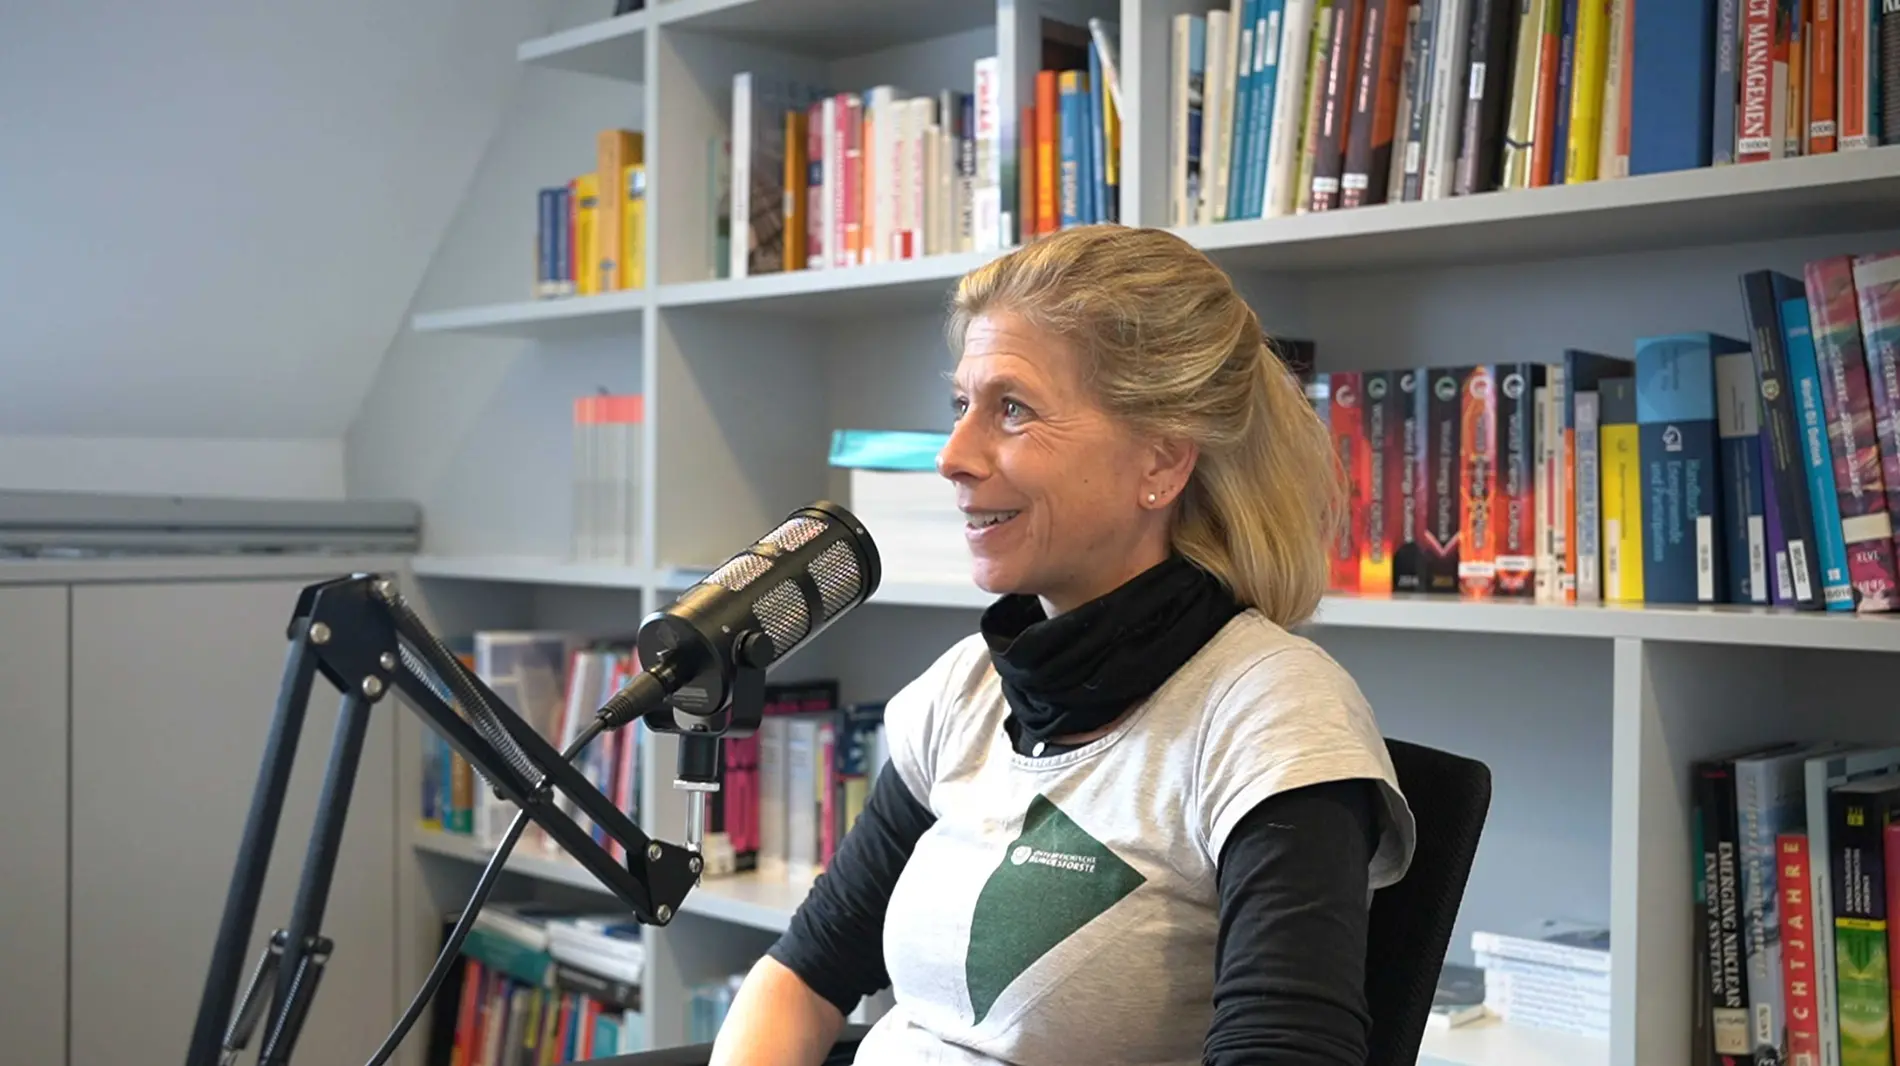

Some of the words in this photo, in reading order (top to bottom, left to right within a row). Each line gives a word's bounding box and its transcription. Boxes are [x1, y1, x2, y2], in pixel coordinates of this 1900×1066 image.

[1403, 419, 1416, 450] World
[1439, 420, 1451, 450] World
[1402, 453, 1415, 496] Energy
[1436, 454, 1450, 500] Energy
[1506, 453, 1522, 497] Energy
[1402, 498, 1415, 544] Outlook
[1438, 502, 1450, 543] Outlook
[1508, 501, 1522, 550] Outlook
[1704, 852, 1720, 915] ENERGY
[1719, 842, 1738, 932] EMERGING
[1708, 919, 1724, 994] SYSTEMS
[1722, 932, 1742, 1008] NUCLEAR
